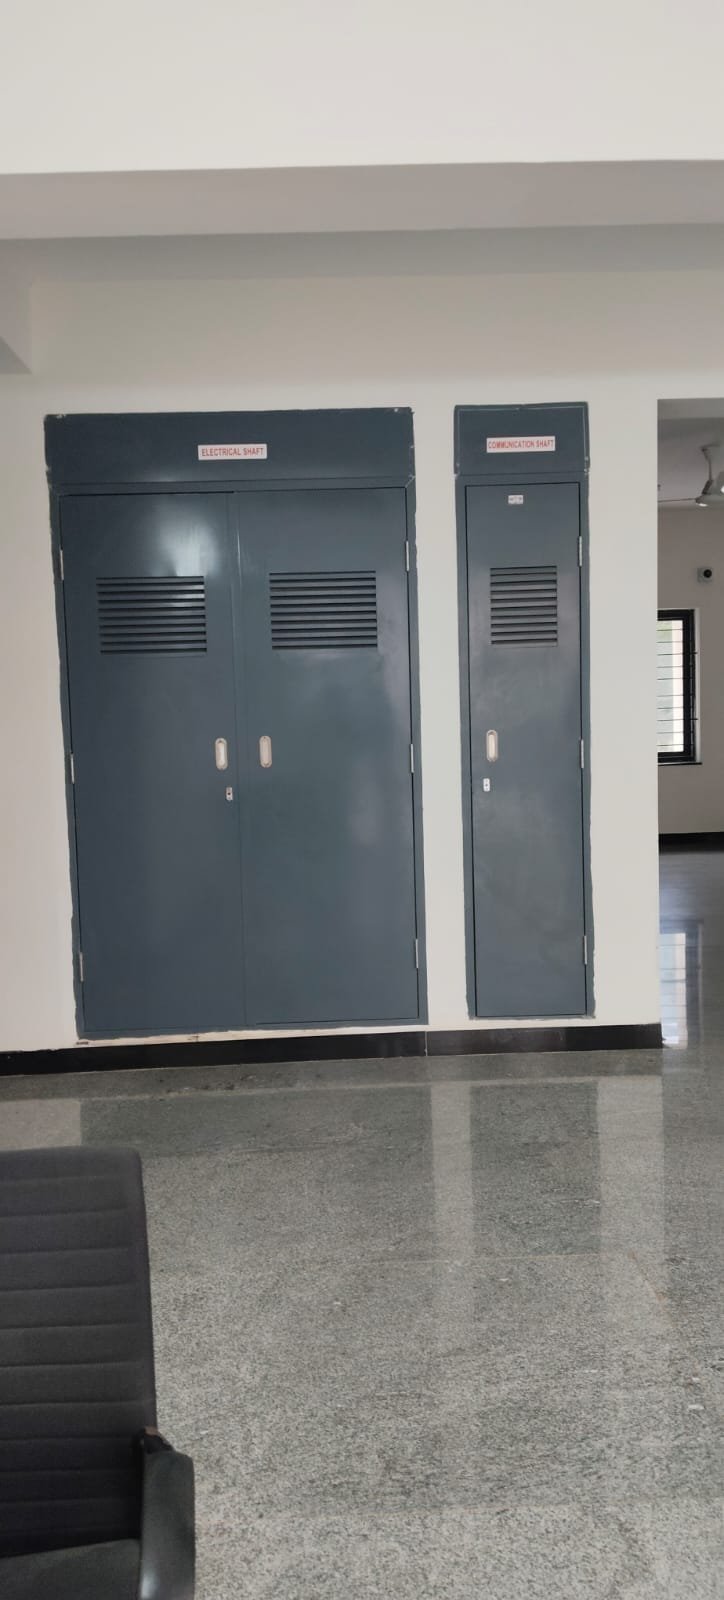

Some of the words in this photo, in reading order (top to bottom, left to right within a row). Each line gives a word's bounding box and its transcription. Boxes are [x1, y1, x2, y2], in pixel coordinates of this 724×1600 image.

[488, 440, 534, 449] COMMUNICATION
[536, 439, 554, 448] SHAFT
[201, 447, 241, 457] ELECTRICAL
[243, 447, 264, 456] SHAFT
